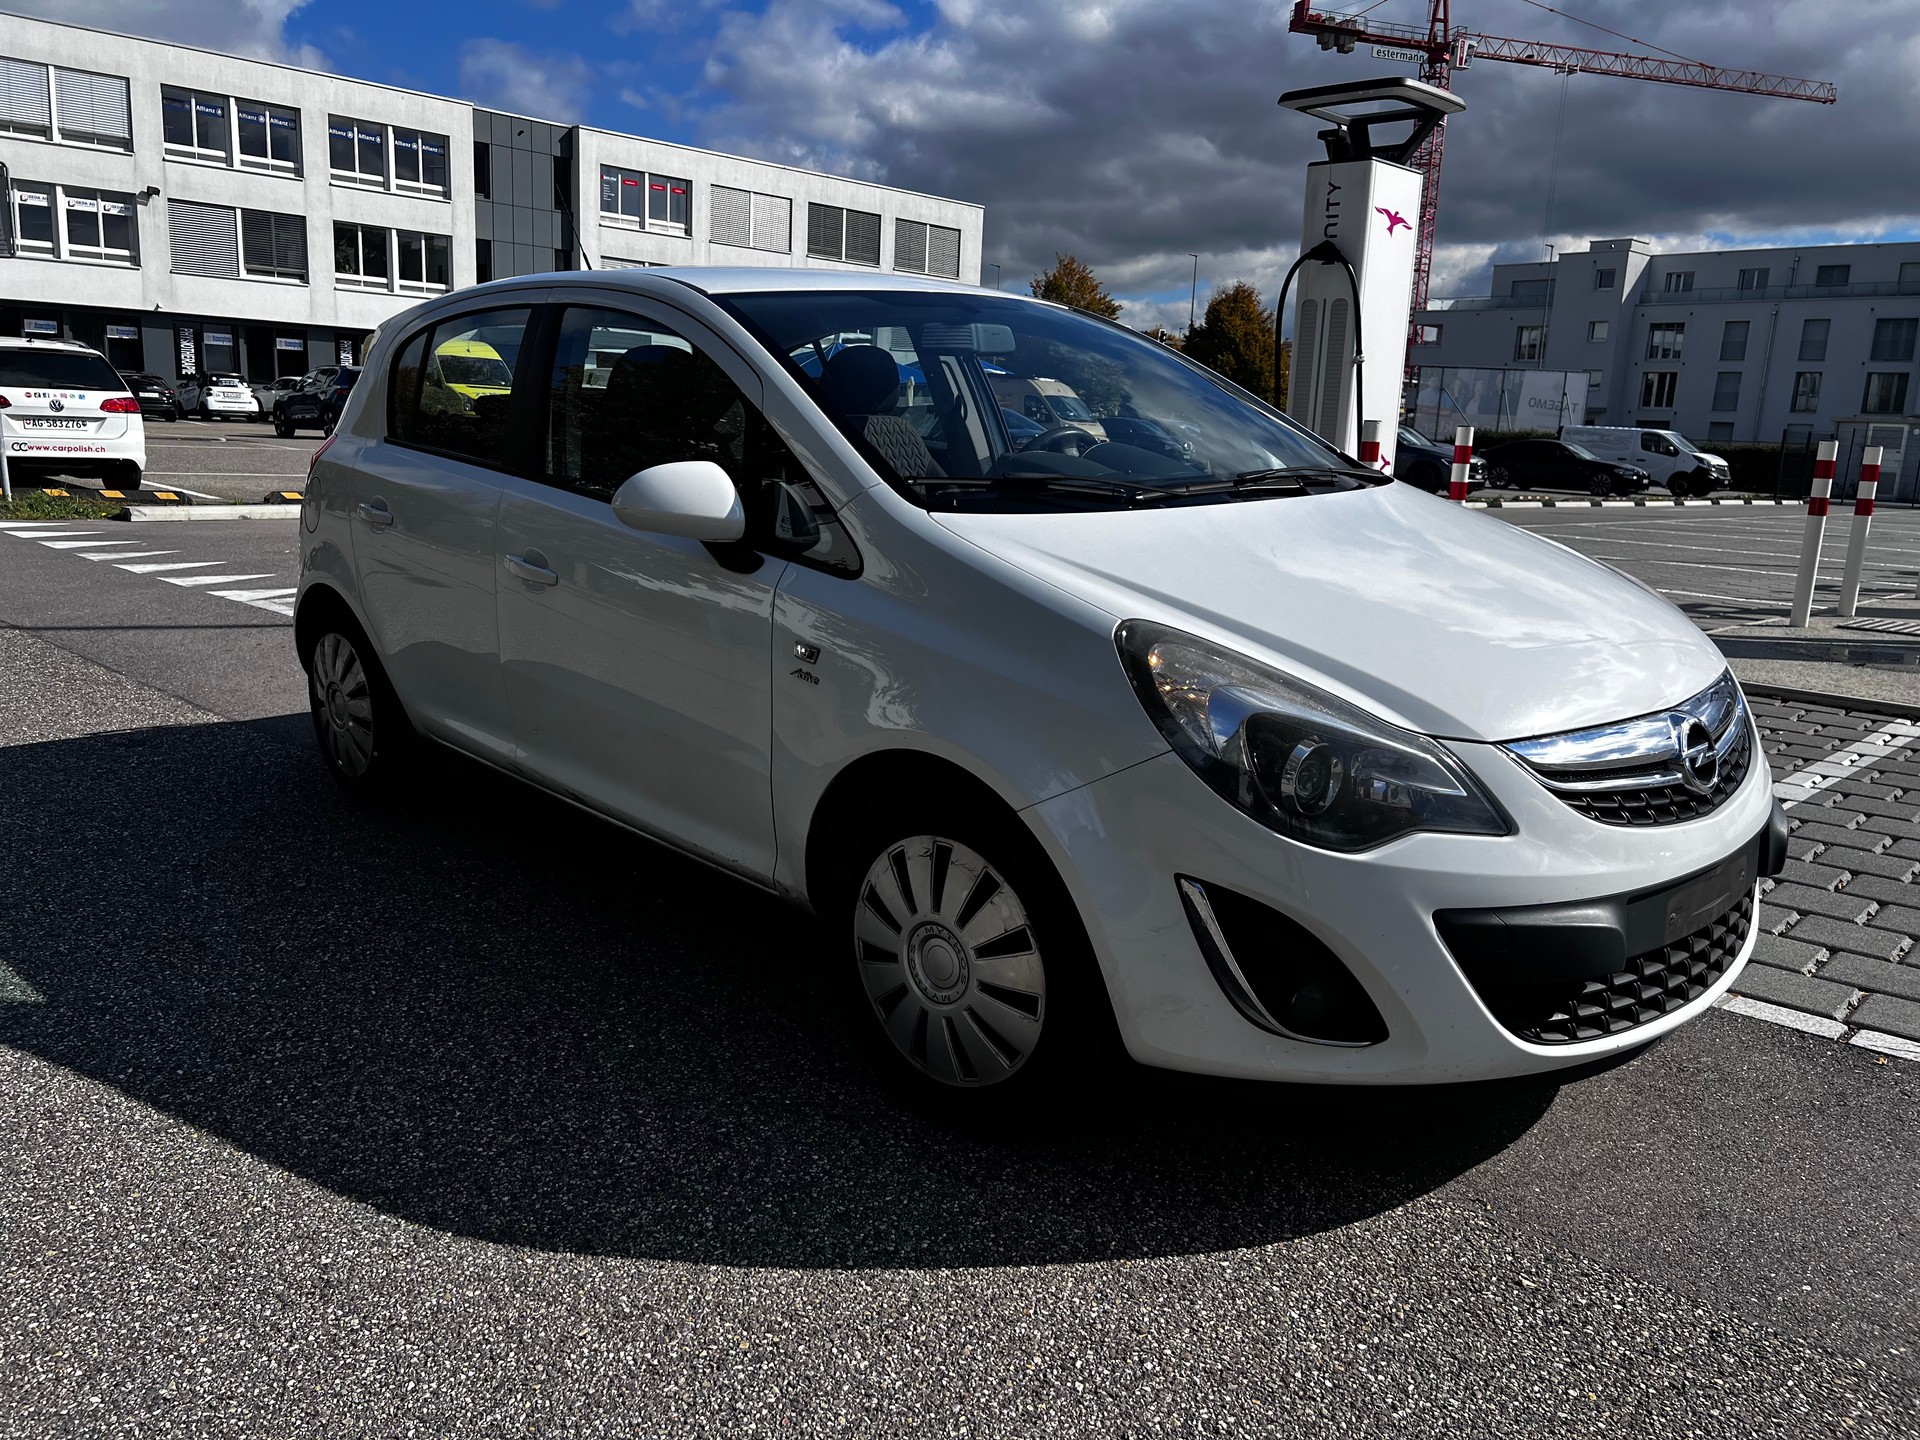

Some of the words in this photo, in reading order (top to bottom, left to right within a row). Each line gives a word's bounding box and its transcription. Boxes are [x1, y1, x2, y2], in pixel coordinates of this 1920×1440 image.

[1376, 48, 1425, 63] estermann
[196, 105, 215, 114] Allianz
[239, 113, 257, 121] Allianz
[270, 118, 288, 126] Allianz
[329, 128, 346, 137] Allianz
[358, 133, 375, 141] Allianz
[395, 140, 411, 148] Allianz
[422, 145, 438, 153] Allianz
[179, 327, 196, 375] PHYSIOTHERAPIE
[340, 339, 353, 366] PHYSIOTH
[28, 444, 106, 453] www.carpolish.ch
[924, 926, 967, 985] MYTHOS
[910, 943, 951, 1001] MYTHOS
